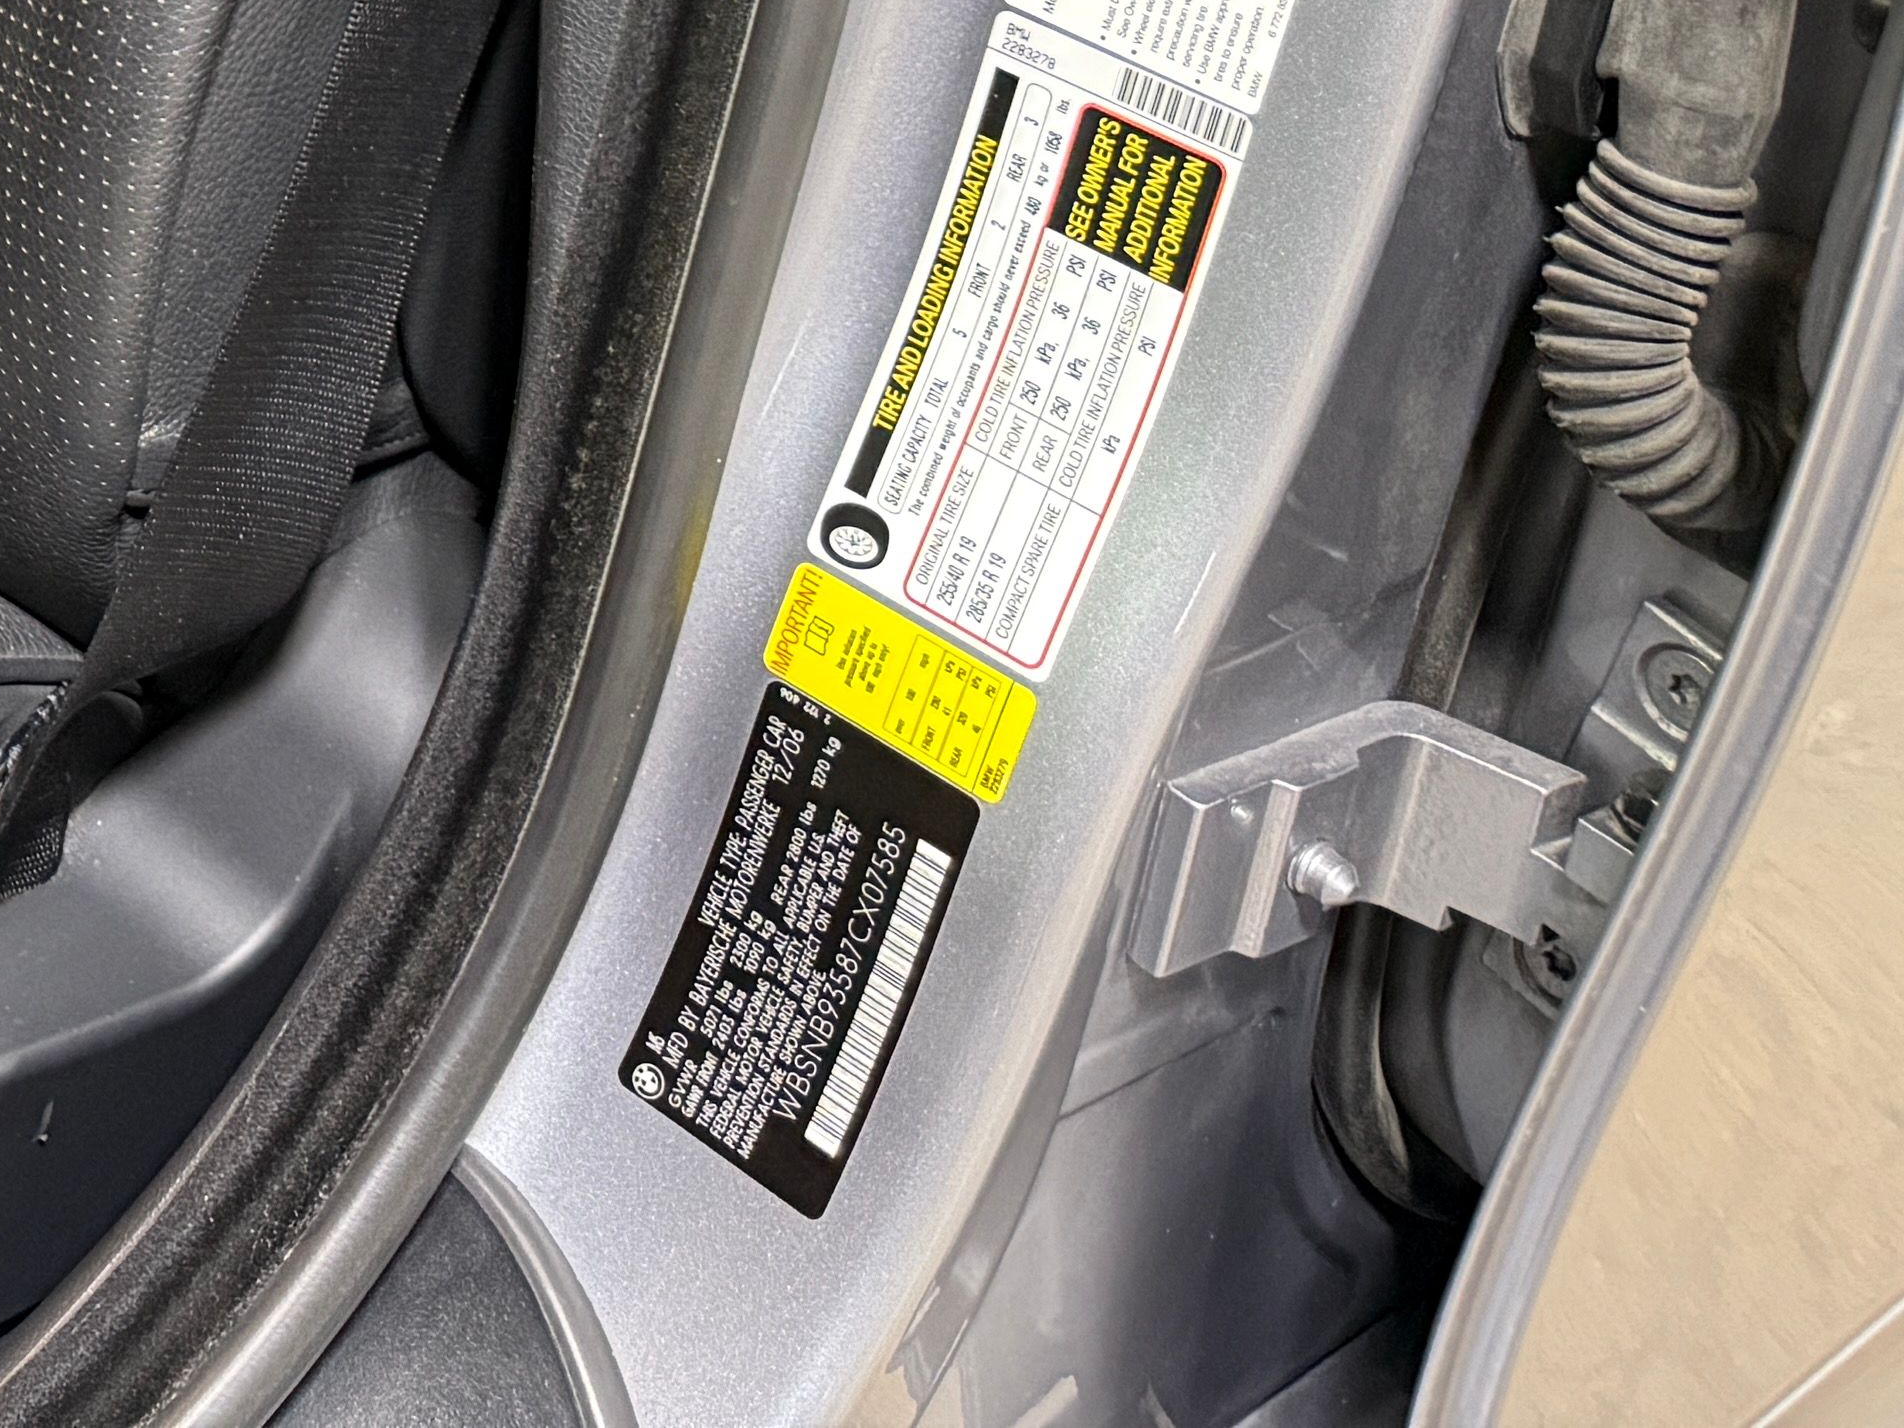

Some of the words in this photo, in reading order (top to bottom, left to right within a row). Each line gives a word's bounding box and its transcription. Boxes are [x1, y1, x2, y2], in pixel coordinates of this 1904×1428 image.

[1100, 5, 1117, 31] Must
[1115, 17, 1131, 38] See
[1132, 12, 1150, 44] Wheel
[1149, 17, 1167, 53] require
[1165, 7, 1188, 61] precaution
[1202, 23, 1220, 53] BMW
[1225, 12, 1243, 47] ensure
[1181, 23, 1204, 67] servicing
[1195, 54, 1211, 74] Use
[1220, 48, 1231, 59] to
[1212, 60, 1227, 82] tires
[1230, 55, 1247, 91] proper
[1246, 71, 1262, 98] BMW
[1039, 162, 1048, 172] or
[1078, 119, 1121, 204] OWNER'S
[1095, 179, 1136, 252] MANUAL
[1118, 134, 1148, 176] FOR
[1125, 156, 1176, 263] ADDITIONAL
[1013, 219, 1031, 253] exceed
[1065, 203, 1094, 242] SEE
[1149, 157, 1208, 283] INFORMATION
[874, 387, 907, 431] TIRE
[892, 346, 923, 391] AND
[909, 263, 955, 349] LOADING
[939, 136, 999, 266] INFORMATION
[1004, 254, 1018, 280] never
[883, 462, 912, 506] SEATING
[901, 413, 932, 463] CAPACITY
[923, 377, 949, 408] TOTAL
[951, 327, 967, 338] 5
[967, 261, 990, 298] FRONT
[990, 219, 1006, 231] 2
[1005, 153, 1027, 182] REAR
[1023, 115, 1039, 126] 3
[992, 281, 1010, 313] should
[974, 405, 998, 442] COLD
[988, 375, 1011, 404] TIRE
[1000, 308, 1035, 376] INFLATION
[1025, 239, 1059, 310] PRESSURE
[981, 315, 998, 341] cargo
[975, 340, 987, 360] and
[998, 412, 1027, 460] FRONT
[1018, 379, 1041, 405] 250
[1050, 301, 1070, 320] 36
[1065, 253, 1086, 277] PSI
[1031, 434, 1058, 472] REAR
[1049, 395, 1071, 421] 250
[1081, 316, 1101, 335] 36
[1095, 268, 1117, 292] PSI
[955, 362, 981, 407] occupants
[1058, 449, 1083, 487] COLD
[1072, 419, 1096, 449] TIRE
[1085, 352, 1121, 420] INFLATION
[1110, 281, 1146, 353] PRESSURE
[1100, 434, 1120, 454] kPa
[1137, 335, 1156, 356] PSI
[950, 406, 961, 418] of
[938, 419, 957, 450] weight
[918, 451, 943, 497] combined
[907, 498, 924, 516] The
[915, 528, 949, 585] ORIGINAL
[939, 495, 961, 524] TIRE
[951, 464, 974, 496] SIZE
[952, 552, 970, 566] R
[958, 535, 976, 552] 19
[987, 552, 1006, 568] 19
[936, 564, 964, 606] 255/40
[981, 569, 1000, 582] R
[994, 574, 1030, 639] COMPACT
[1020, 533, 1048, 577] SPARE
[1038, 503, 1061, 533] TIRE
[769, 568, 823, 675] IMPORTANT!
[965, 580, 994, 623] 285/35
[771, 726, 804, 784] 12/06
[697, 869, 732, 926] VEHICLE
[719, 831, 747, 869] TYPE:
[734, 749, 775, 831] PASSENGER
[762, 715, 787, 748] CAR
[825, 808, 849, 847] THEFT
[845, 823, 862, 844] OF
[721, 798, 780, 919] MOTORENWERKE
[816, 850, 835, 881] AND
[831, 844, 855, 882] DATE
[794, 881, 824, 933] BUMPER
[821, 881, 842, 906] THE
[681, 1084, 704, 1117] GAWR
[695, 1050, 718, 1087] FRONT
[711, 1013, 735, 1050] 2403
[727, 988, 747, 1013] lbs
[743, 941, 765, 974] 1090
[758, 919, 776, 940] kg
[770, 863, 794, 905] REAR
[785, 827, 807, 862] 2800
[798, 801, 817, 825] lbs
[810, 758, 830, 788] 1270
[821, 736, 841, 757] kg
[814, 908, 831, 932] ON
[688, 915, 736, 1006] BAYERISCHE
[772, 821, 905, 1120] WBSNB93587CX07585
[776, 936, 806, 985] SAFETY,
[795, 932, 821, 979] EFFECT
[695, 1099, 717, 1127] THIS
[709, 1048, 741, 1097] VEHICLE
[733, 977, 770, 1048] CONFORMS
[761, 955, 778, 975] TO
[772, 930, 789, 956] ALL
[782, 855, 817, 929] APPLICABLE
[807, 831, 826, 854] U.S.
[788, 978, 804, 996] IN
[667, 1058, 698, 1109] GVWR
[700, 1004, 722, 1038] 5071
[713, 979, 733, 1004] lbs
[729, 932, 751, 967] 2300
[744, 910, 763, 933] kg
[677, 1004, 700, 1031] BY
[754, 984, 785, 1033] VEHICLE
[661, 1031, 688, 1069] MFD
[757, 996, 797, 1072] STANDARDS
[734, 1036, 763, 1085] MOTOR
[737, 1062, 786, 1159] MANUFACTURE
[778, 1014, 807, 1065] SHOWN
[709, 1085, 742, 1141] FEDERAL
[724, 1072, 765, 1150] PREVENTION
